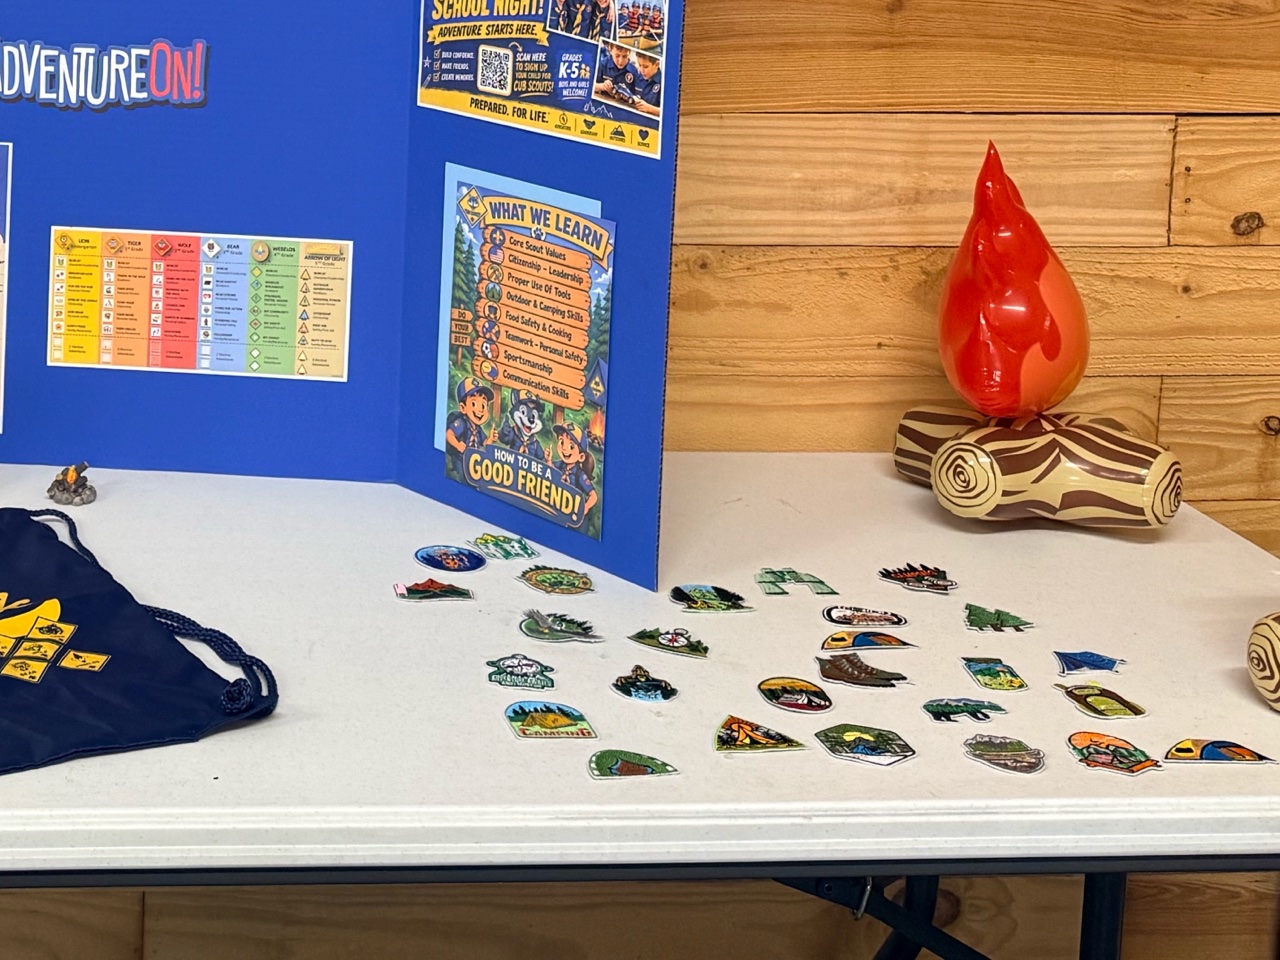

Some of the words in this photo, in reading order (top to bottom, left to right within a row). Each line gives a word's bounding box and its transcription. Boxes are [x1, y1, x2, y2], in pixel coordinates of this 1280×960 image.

[438, 24, 482, 37] ADVENTURE
[486, 24, 514, 36] STARTS
[515, 24, 537, 36] HERE.
[559, 63, 579, 79] K-5
[470, 97, 509, 116] PREPARED.
[512, 107, 527, 119] FOR
[529, 111, 549, 123] LIFE.
[489, 201, 526, 221] WHAT
[530, 206, 551, 228] WE
[555, 214, 603, 251] LEARN
[509, 236, 524, 248] Core
[525, 241, 544, 255] Scout
[545, 247, 566, 261] Values
[494, 449, 515, 464] HOW
[517, 455, 529, 468] TO
[531, 462, 543, 475] BE
[545, 468, 552, 480] A
[469, 453, 514, 487] GOOD
[518, 469, 582, 521] FRIEND!
